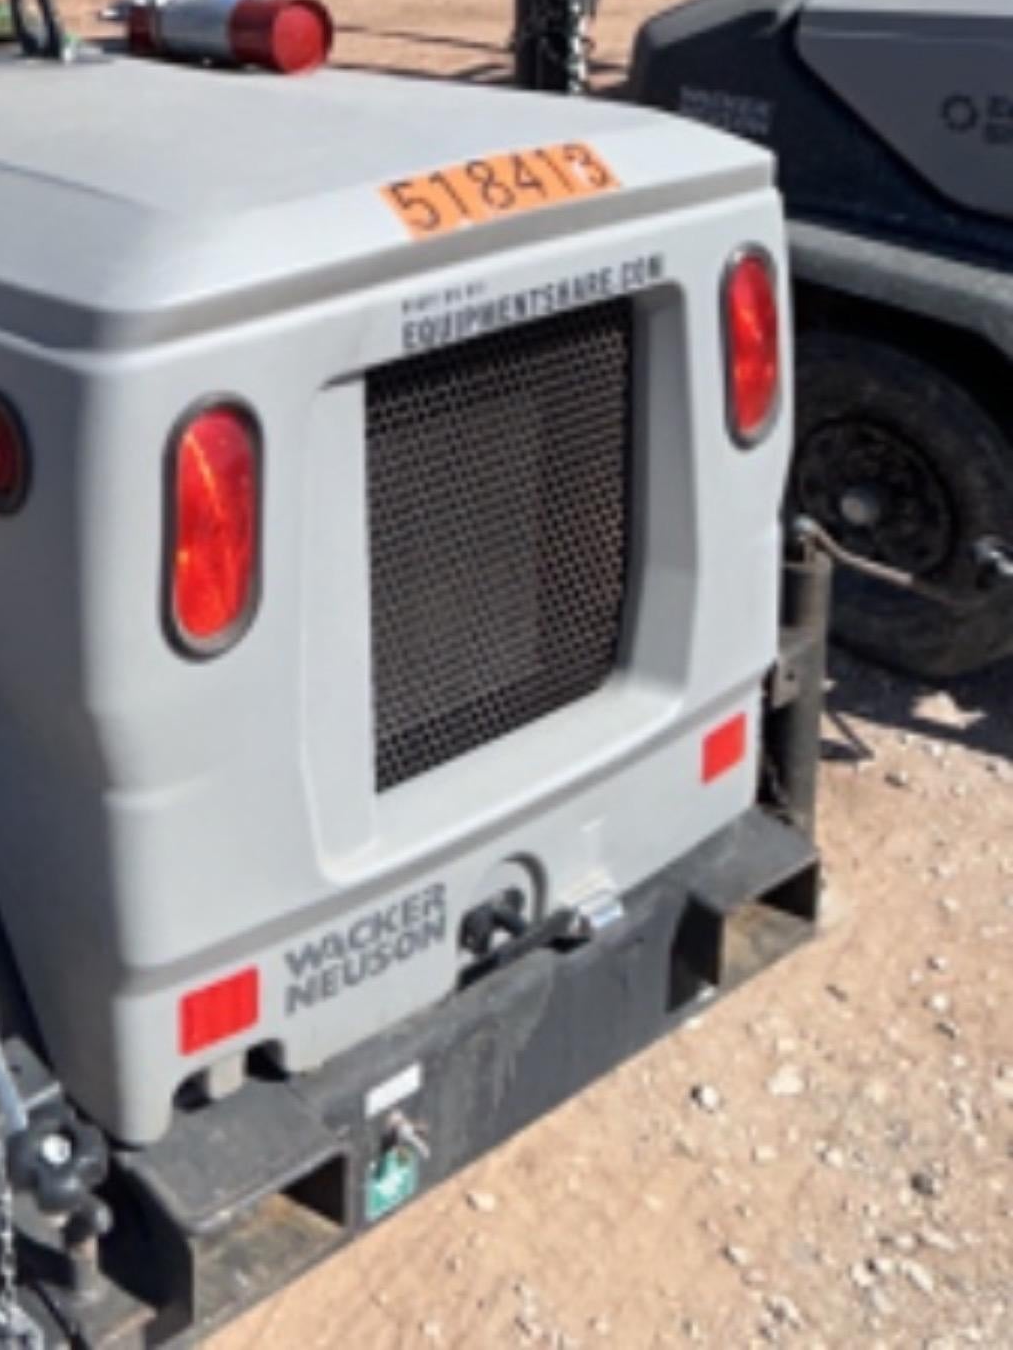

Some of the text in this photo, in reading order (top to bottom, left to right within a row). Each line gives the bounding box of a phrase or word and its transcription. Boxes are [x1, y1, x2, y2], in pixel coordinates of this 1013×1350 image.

[389, 143, 610, 232] 518413
[284, 882, 447, 979] WACKER
[284, 914, 447, 1018] NEUSON
